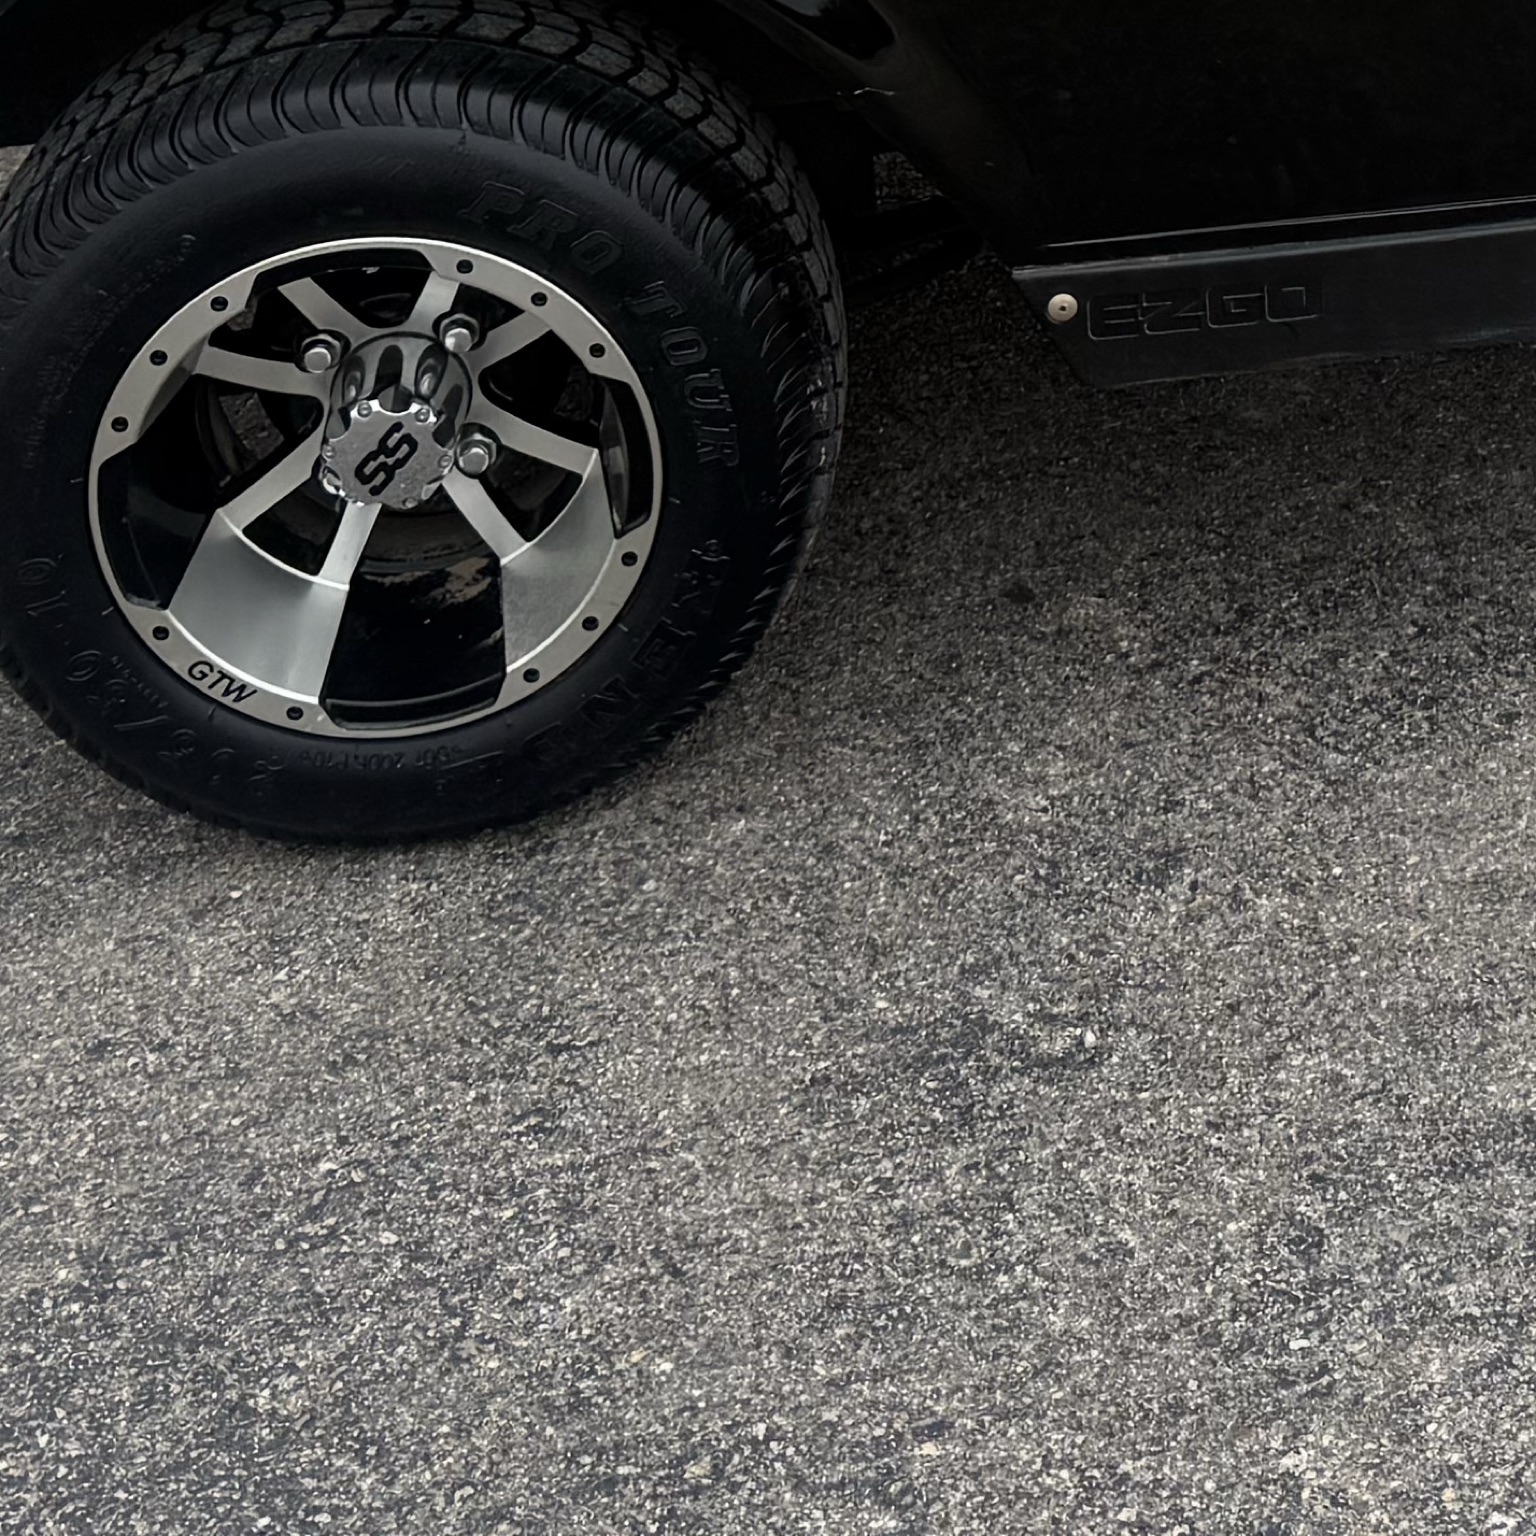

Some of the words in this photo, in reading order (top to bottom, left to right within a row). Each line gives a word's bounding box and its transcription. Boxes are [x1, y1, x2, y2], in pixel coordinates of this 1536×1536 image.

[460, 182, 624, 274] PRO
[628, 282, 744, 467] TOUR
[187, 660, 257, 704] GTW
